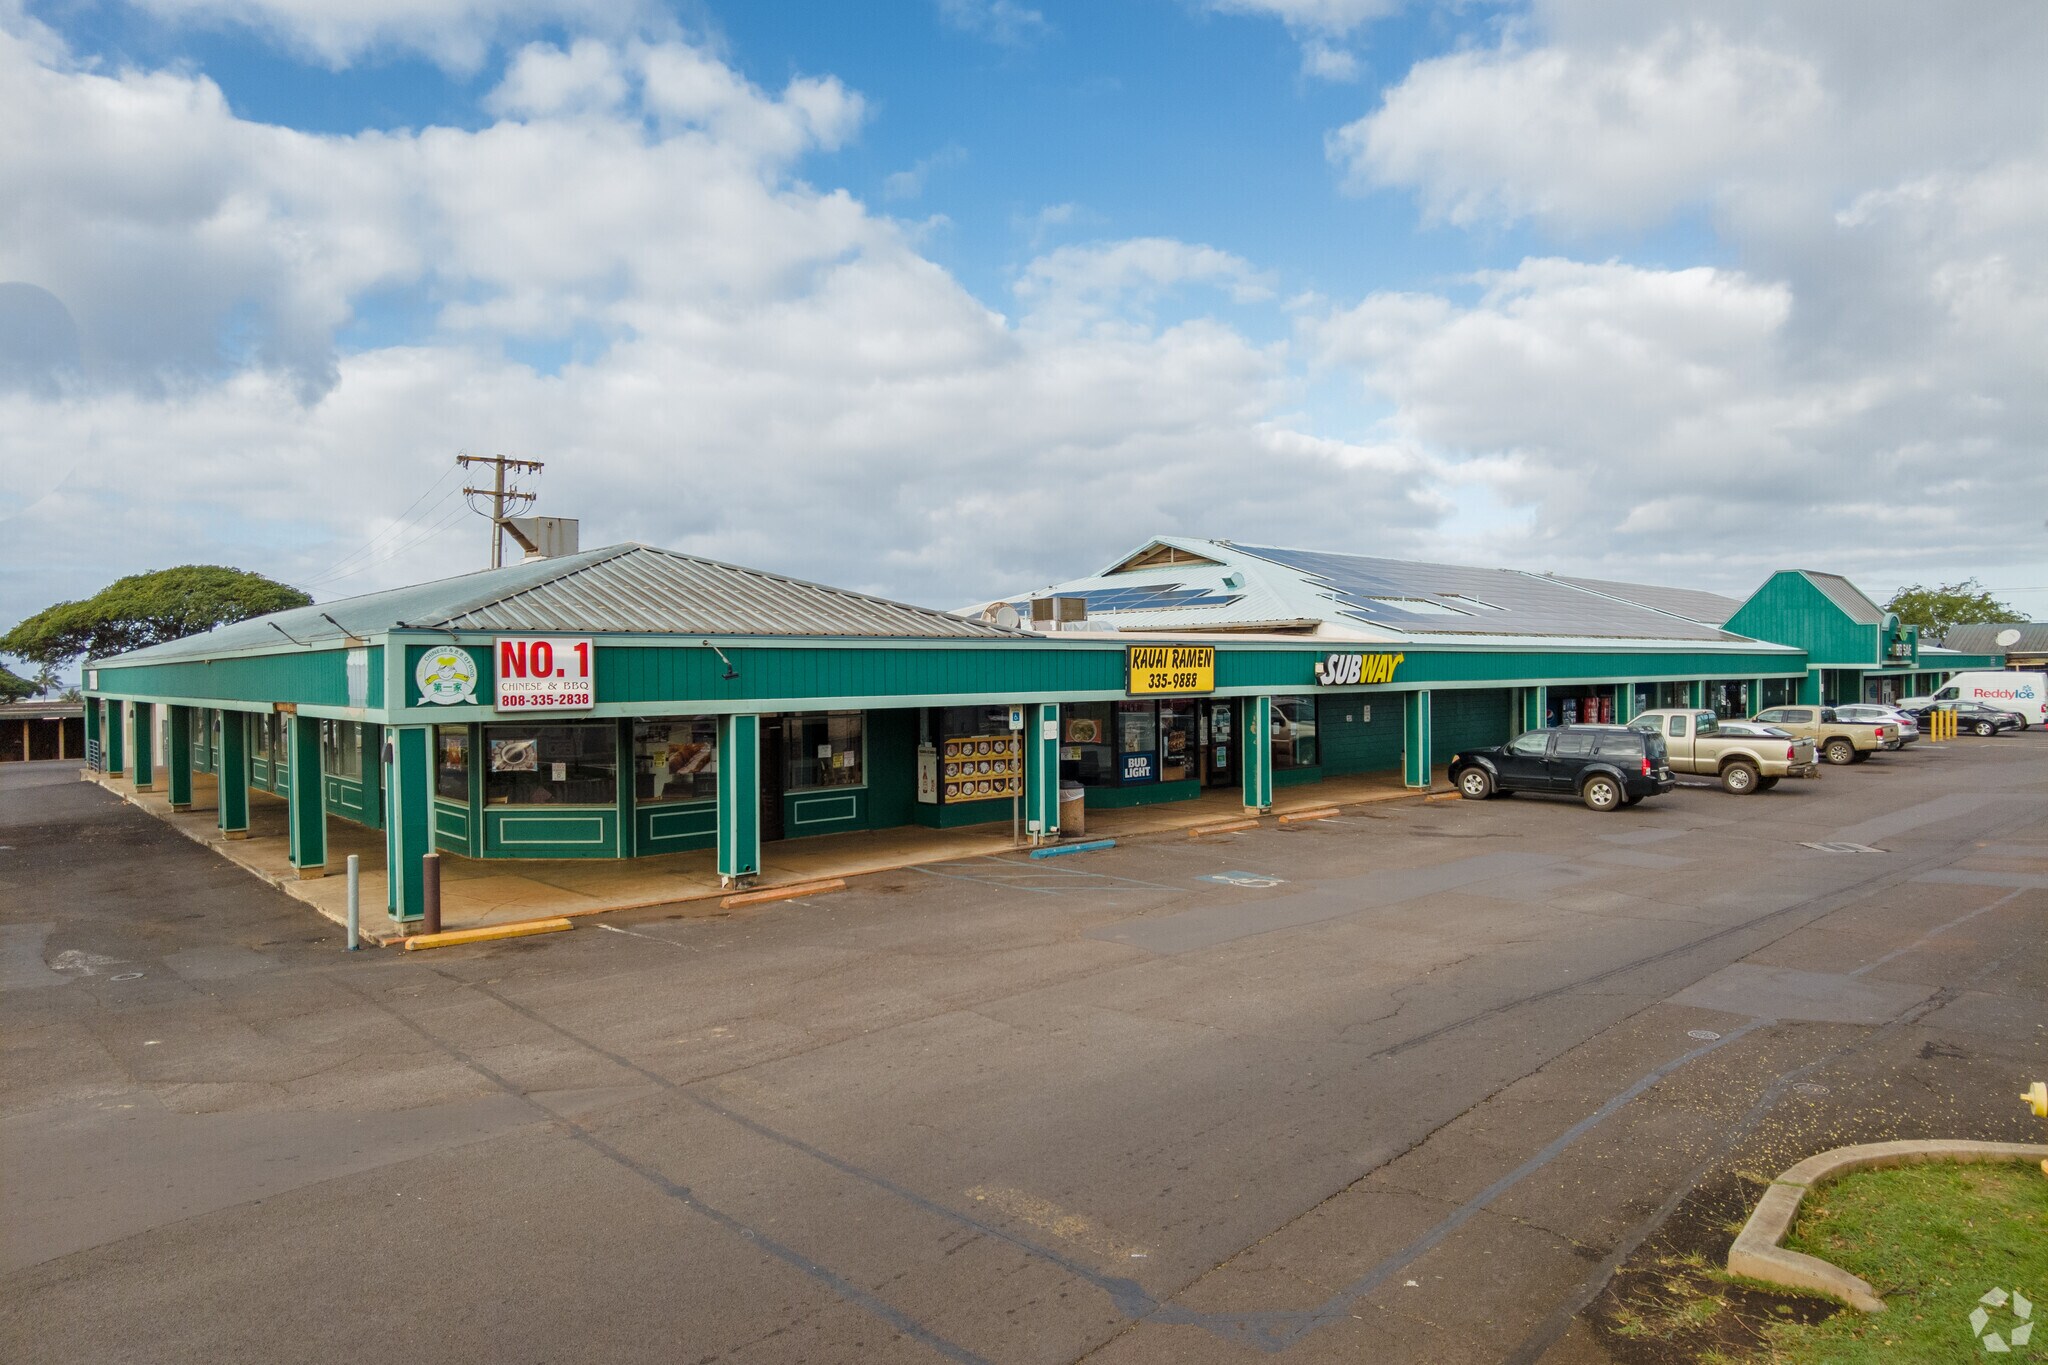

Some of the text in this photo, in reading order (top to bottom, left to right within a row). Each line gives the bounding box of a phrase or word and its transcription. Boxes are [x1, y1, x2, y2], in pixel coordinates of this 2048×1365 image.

[1132, 649, 1212, 670] KAUAI RAMEN
[1320, 652, 1404, 687] SUBWAY
[501, 681, 589, 692] CHINESE & BBQ
[1148, 673, 1197, 689] 335-9888
[502, 693, 589, 707] 808-335-2838
[1127, 757, 1147, 767] BUD
[1124, 766, 1151, 779] LIGHT
